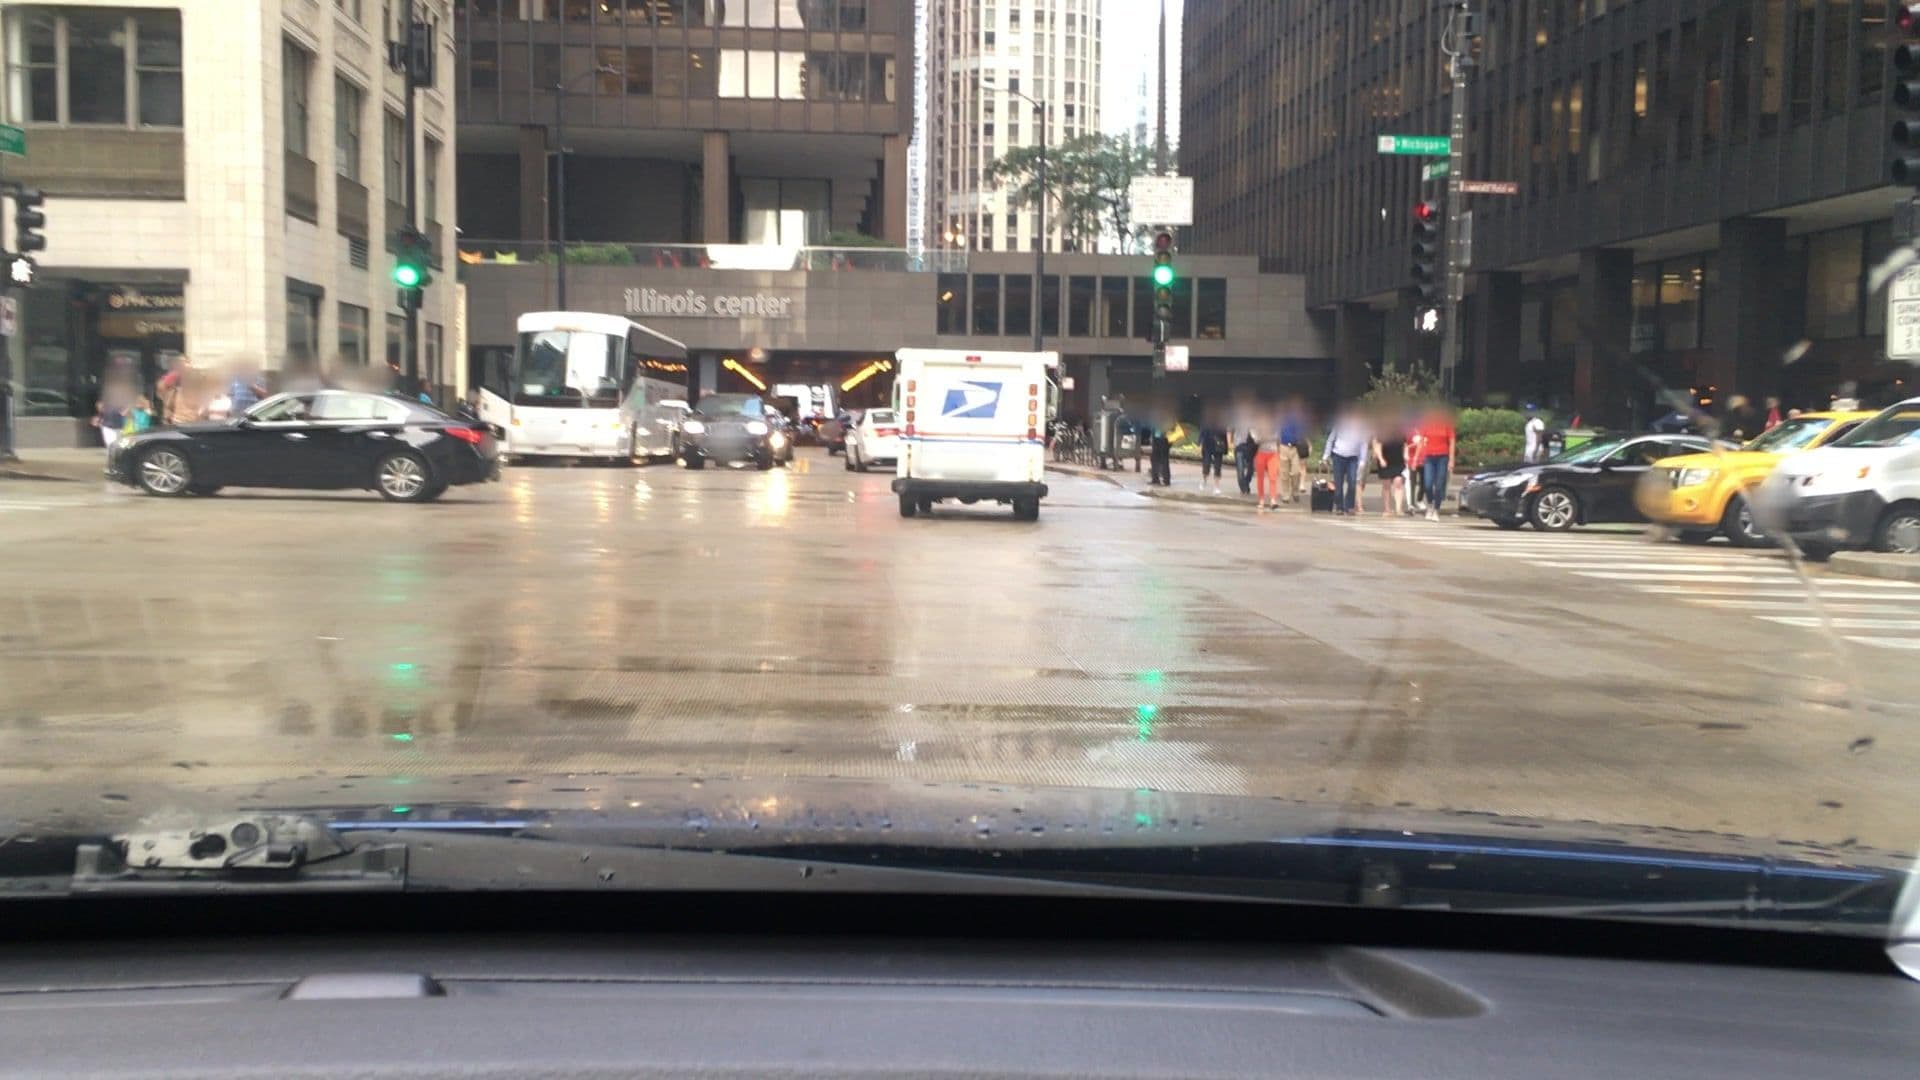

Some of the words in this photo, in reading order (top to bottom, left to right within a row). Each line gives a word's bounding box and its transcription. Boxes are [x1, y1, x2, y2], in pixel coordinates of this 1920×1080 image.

[1401, 138, 1440, 152] Michigan
[623, 287, 707, 313] illinois
[713, 293, 791, 315] center
